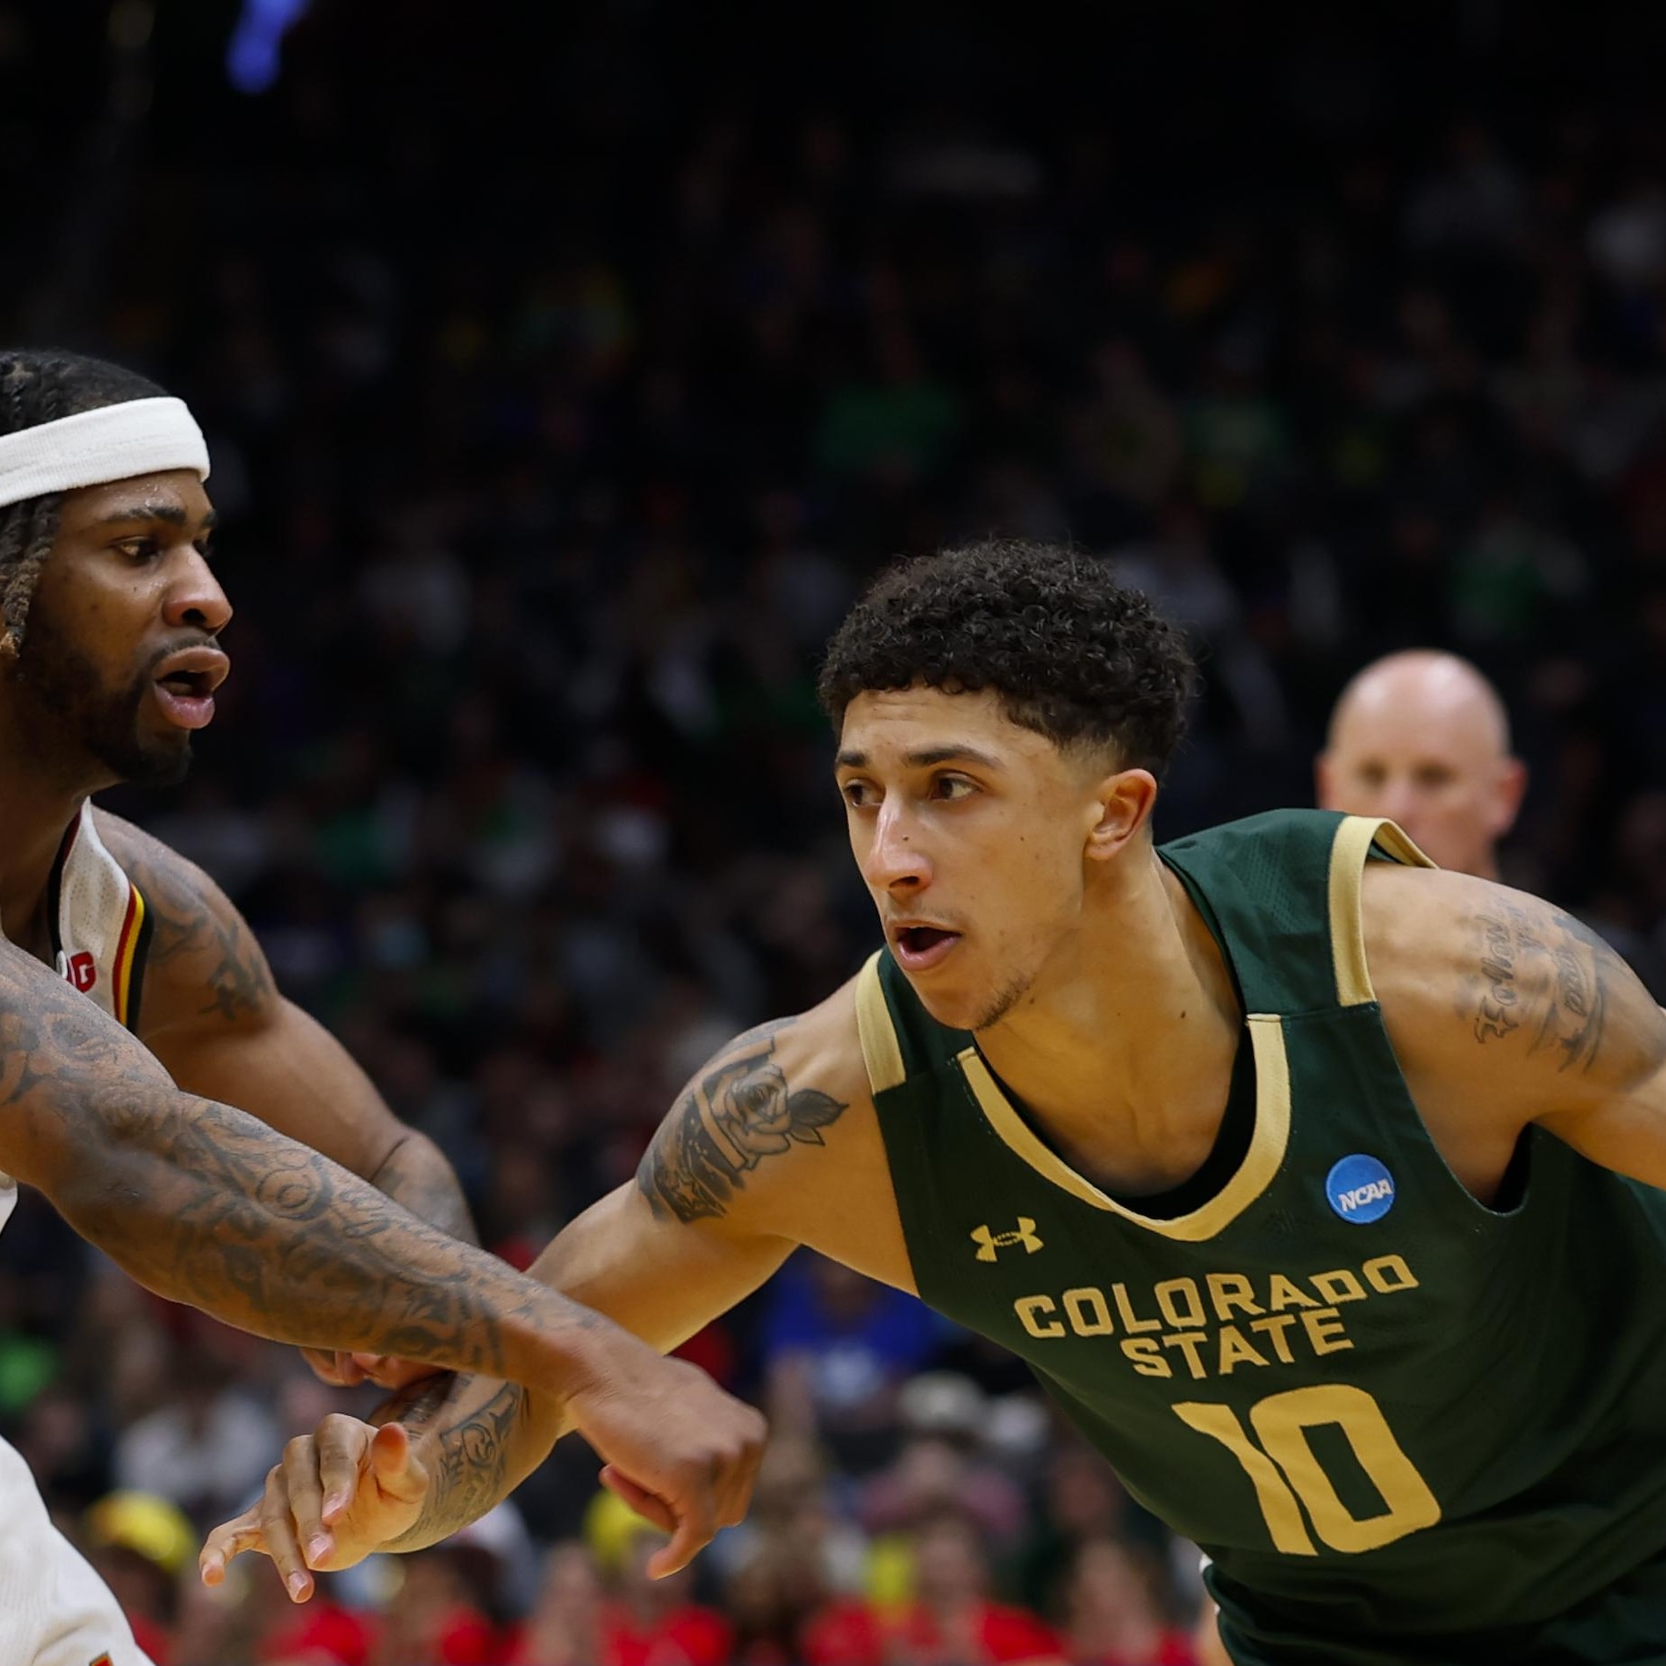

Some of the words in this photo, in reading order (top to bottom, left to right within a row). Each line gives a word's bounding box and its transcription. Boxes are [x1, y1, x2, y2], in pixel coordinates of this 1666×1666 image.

[1338, 1178, 1393, 1212] NCAA
[1014, 1254, 1419, 1338] COLORADO
[1121, 1307, 1354, 1380] STATE
[1171, 1384, 1442, 1556] 10
